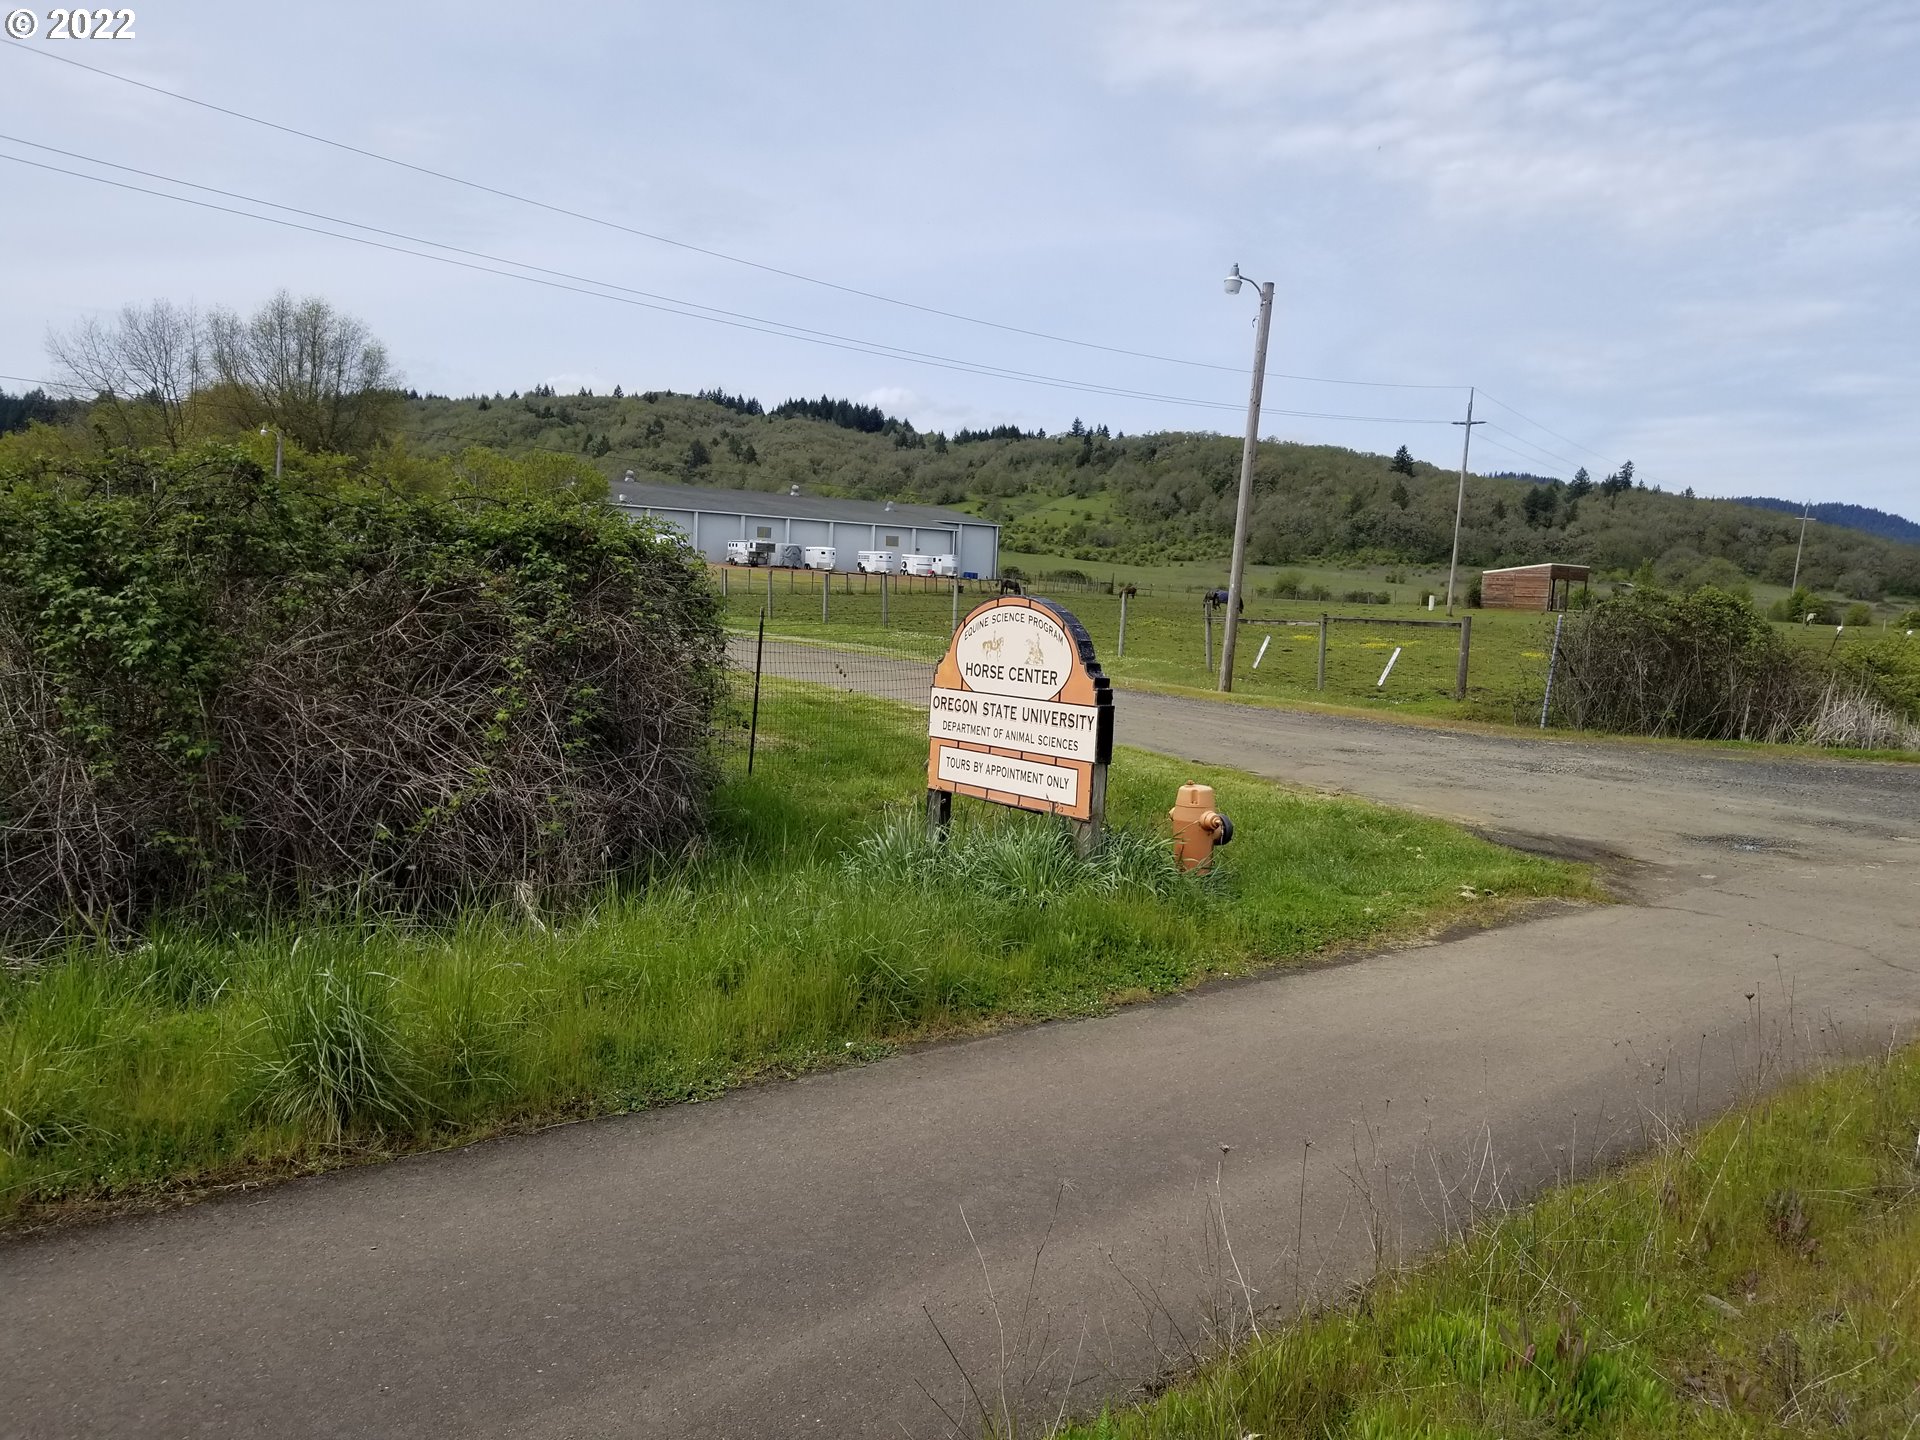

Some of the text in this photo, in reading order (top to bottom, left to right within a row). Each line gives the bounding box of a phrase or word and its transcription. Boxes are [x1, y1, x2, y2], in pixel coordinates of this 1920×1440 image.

[964, 612, 1064, 646] EQUINE SCIENCE PROGRAM
[965, 662, 1058, 686] HORSE CENTER
[933, 695, 1095, 731] OREGON STATE UNIVERSITY
[942, 720, 1079, 752] DEPARTMENT OF ANIMAL SCIENCES
[946, 756, 1070, 790] TOURS BY APPOINTMENT ONLY
